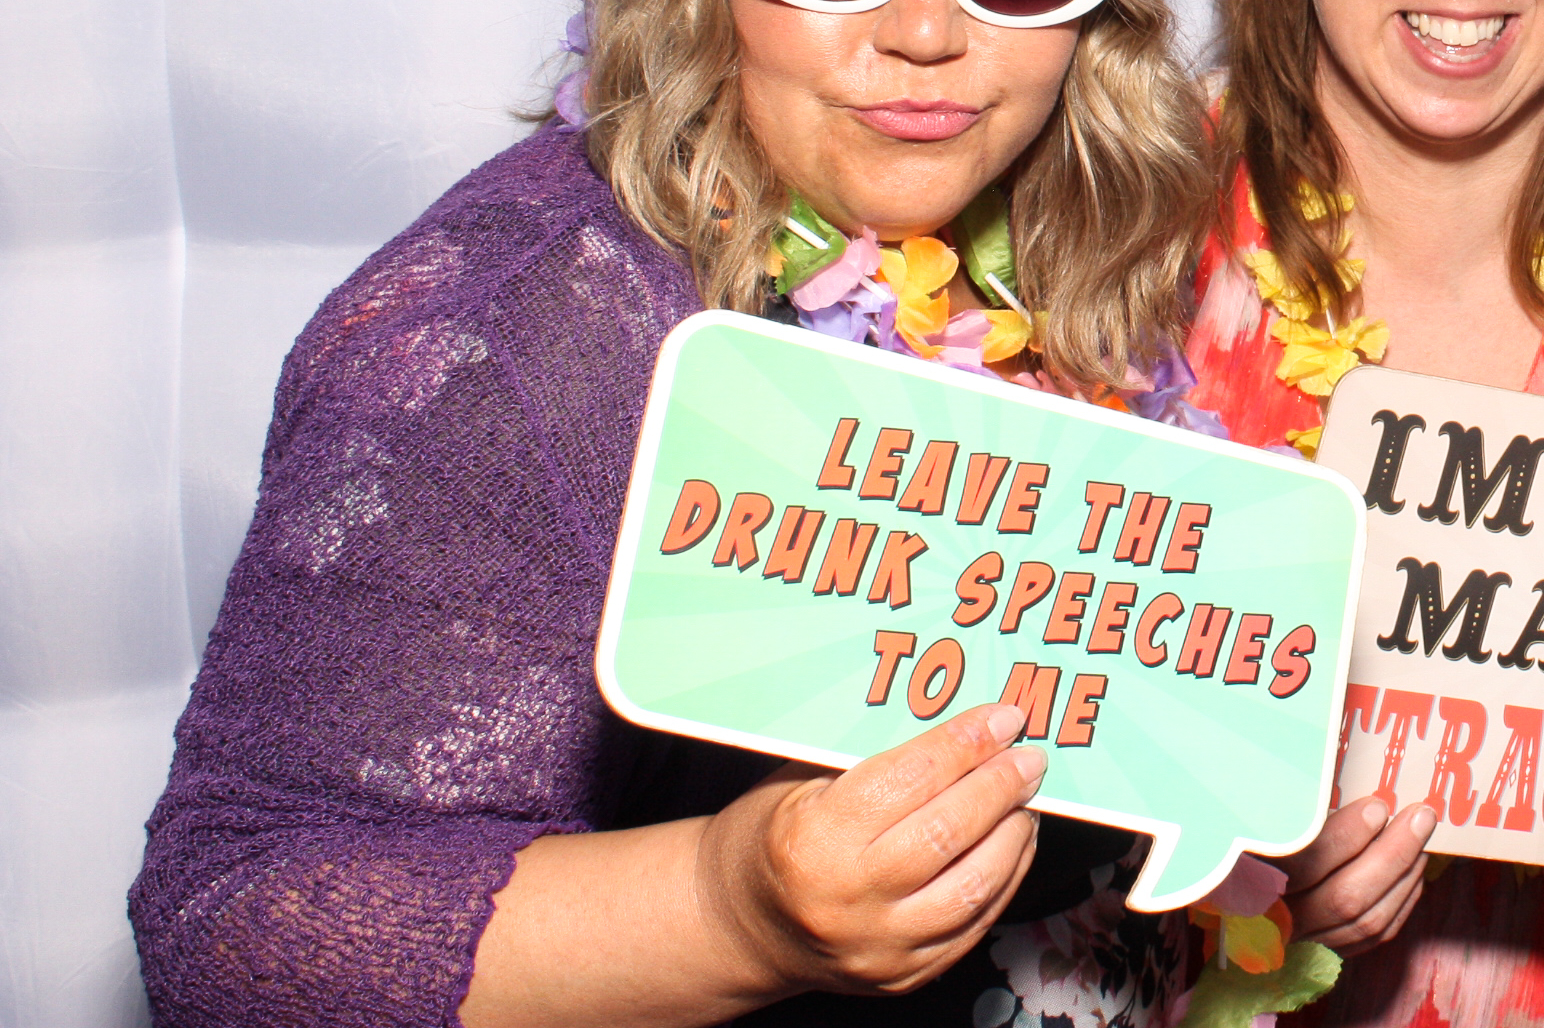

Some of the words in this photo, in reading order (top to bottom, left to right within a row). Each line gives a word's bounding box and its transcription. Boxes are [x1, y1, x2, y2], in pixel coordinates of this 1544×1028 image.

[816, 418, 1050, 533] LEAVE
[1078, 480, 1212, 573] THE
[659, 478, 928, 609] DRUNK
[952, 550, 1317, 699] SPEECHES
[865, 629, 966, 720] TO
[998, 662, 1109, 748] ME
